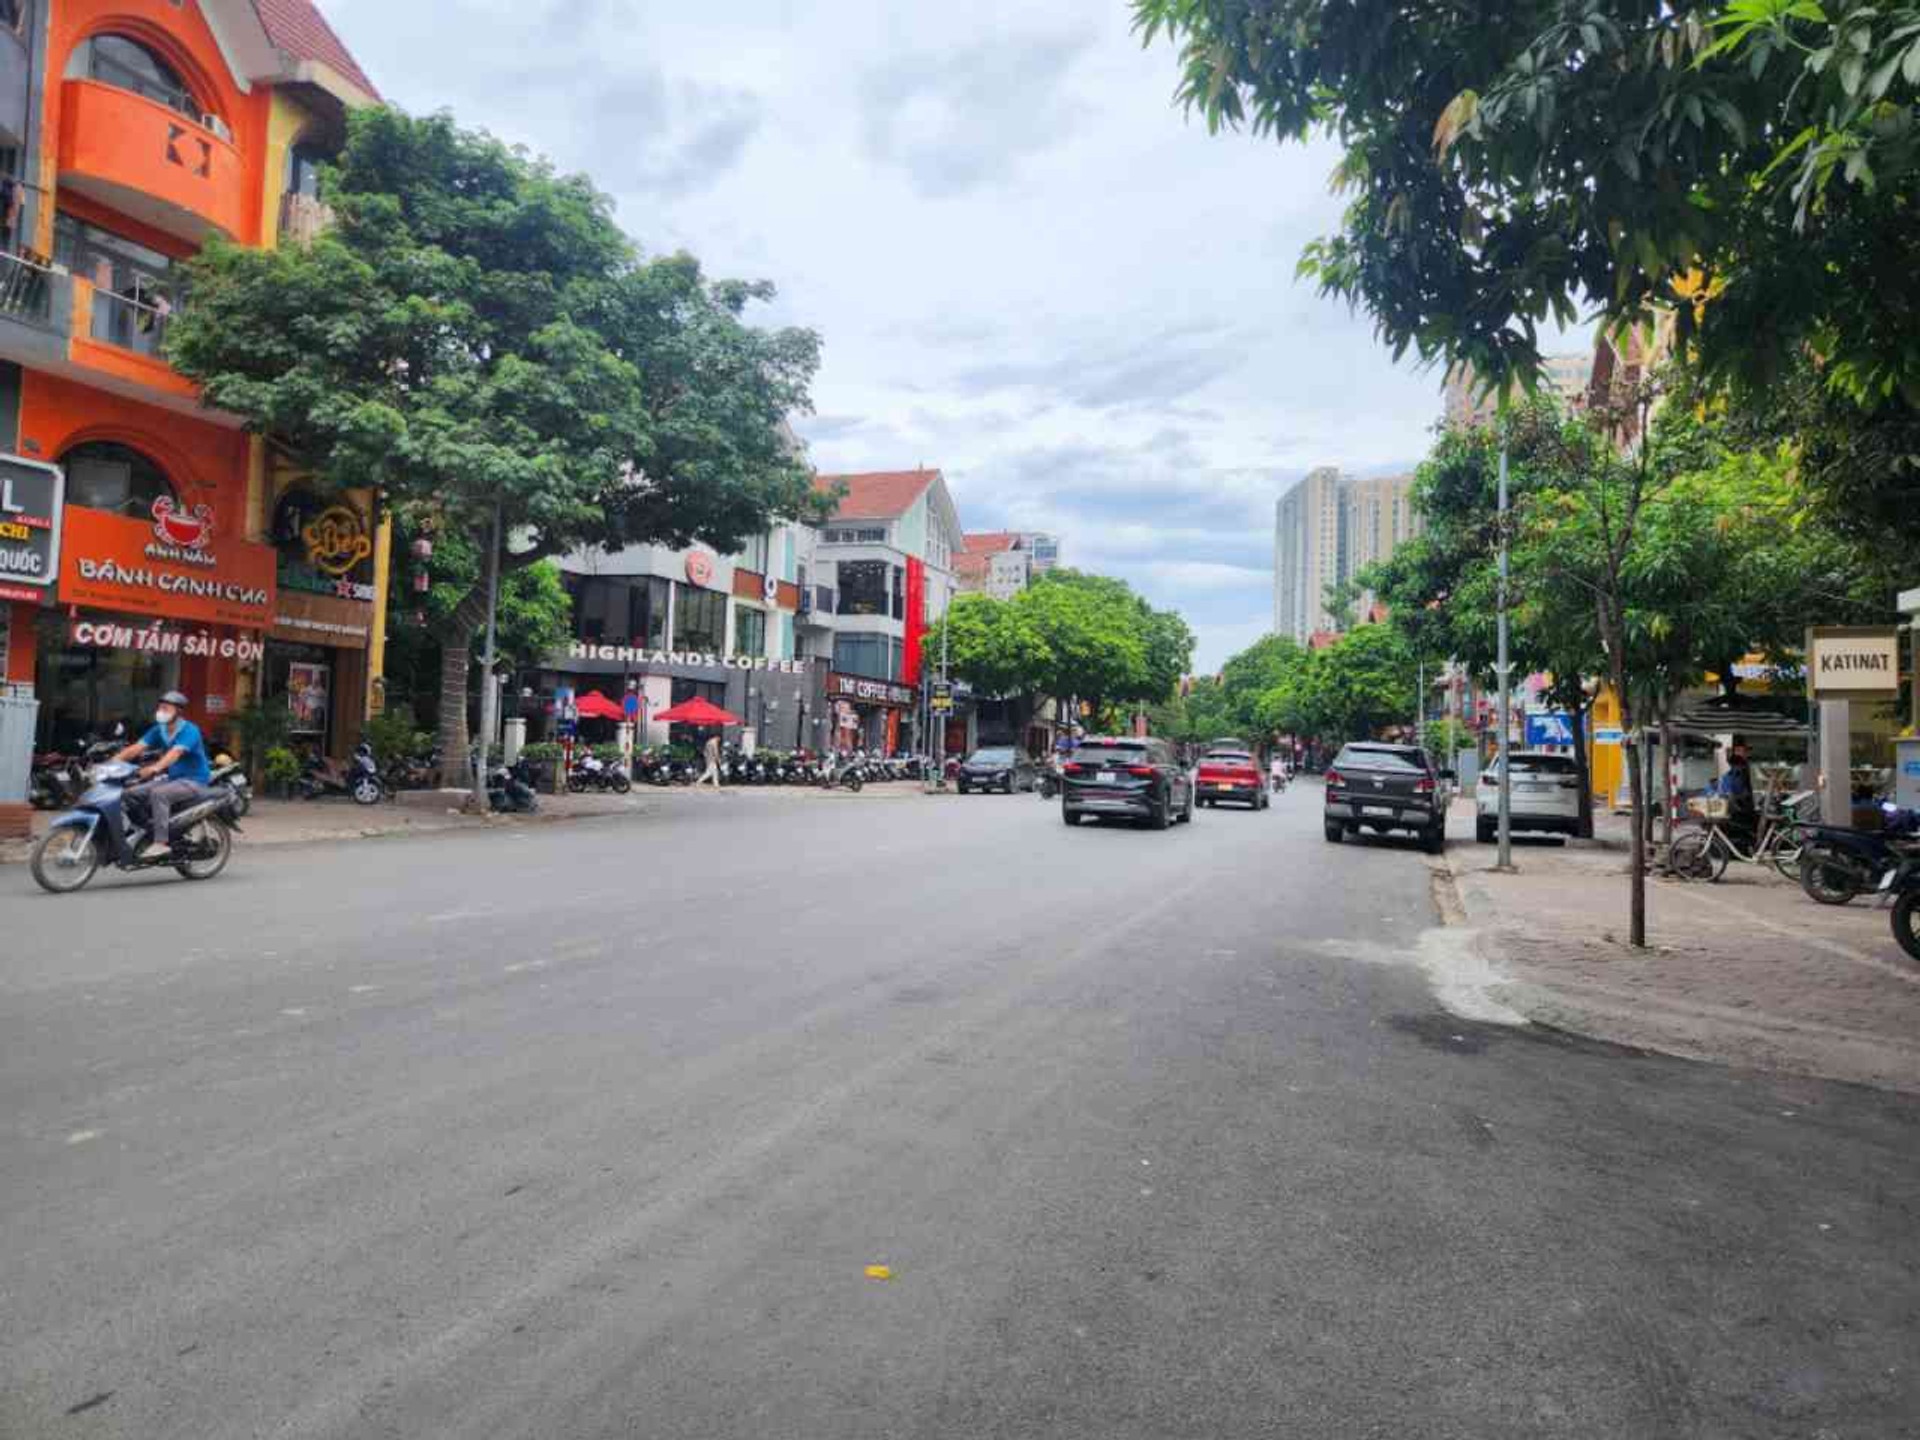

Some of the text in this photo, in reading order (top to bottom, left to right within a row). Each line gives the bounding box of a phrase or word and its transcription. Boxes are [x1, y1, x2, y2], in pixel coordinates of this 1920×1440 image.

[78, 557, 152, 588] BÁNH
[75, 621, 133, 649] CƠM
[135, 618, 181, 653] TẤM
[569, 643, 806, 674] HIGHLANDS COFFEE
[1821, 653, 1889, 673] KATINAT
